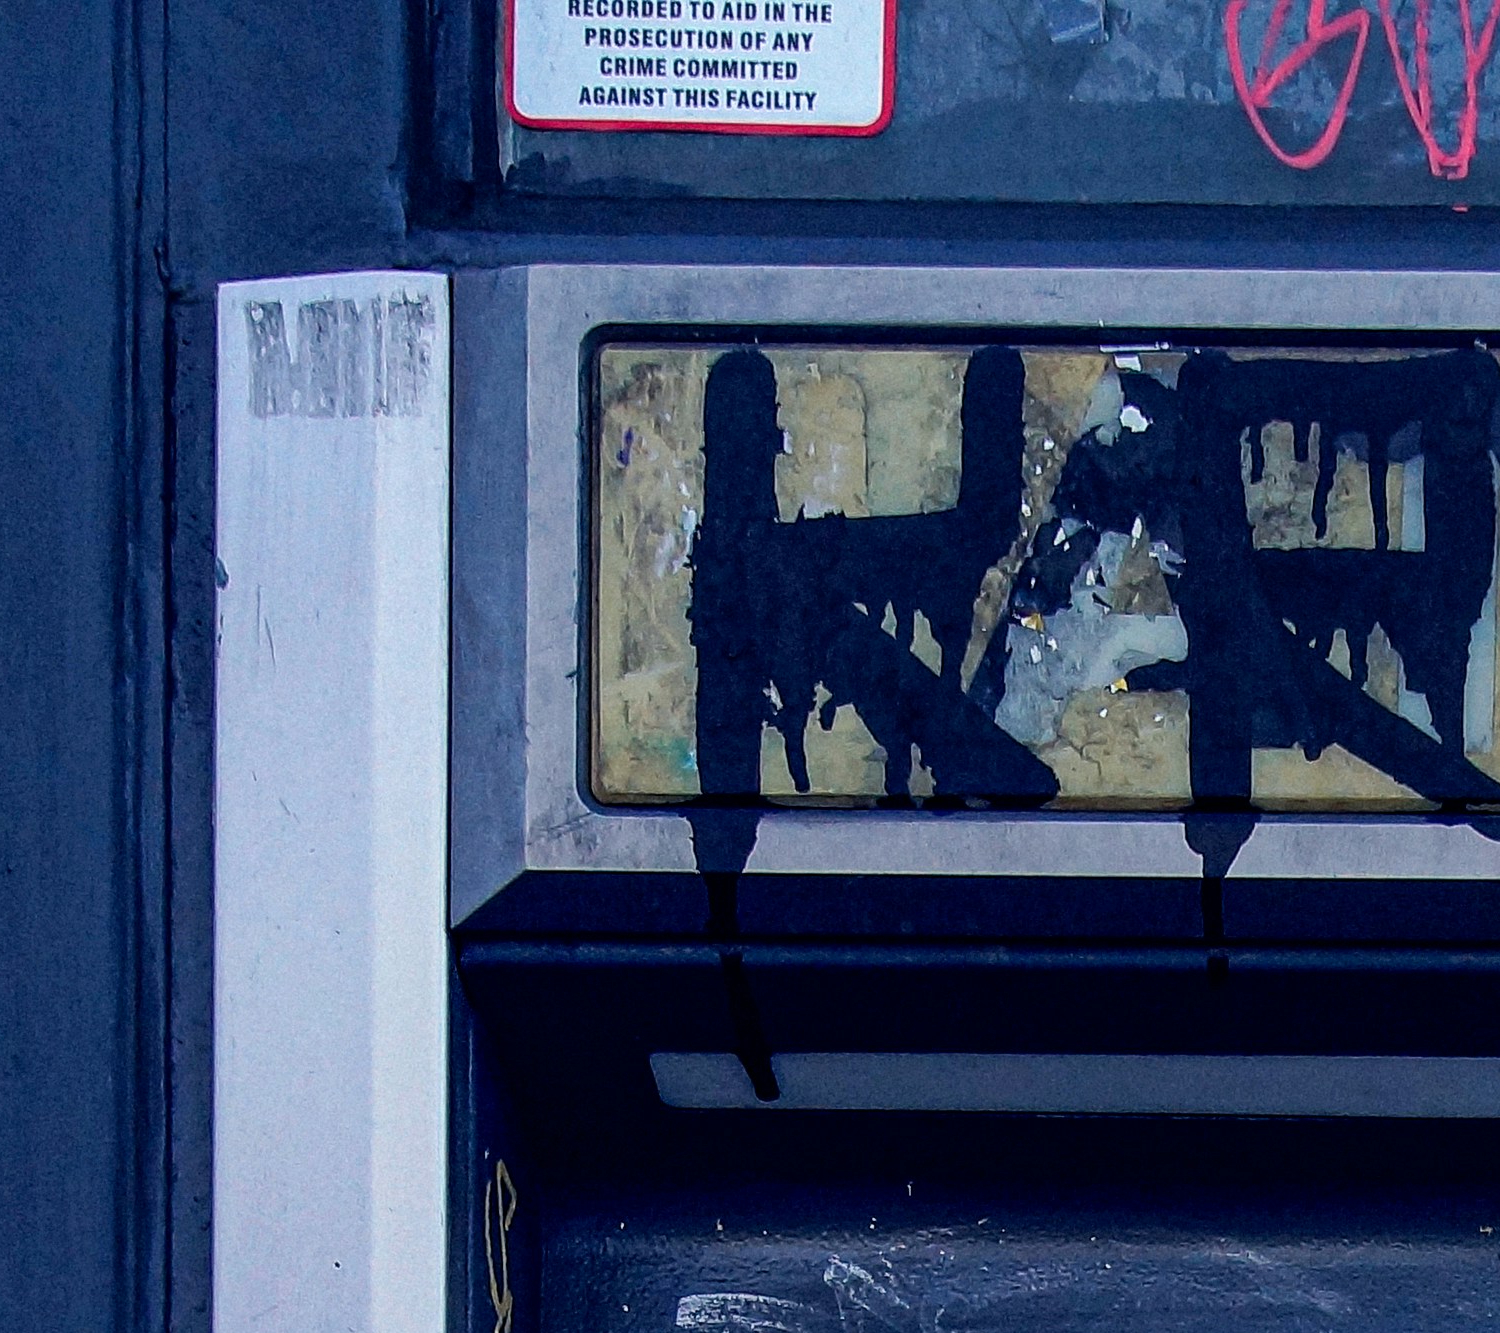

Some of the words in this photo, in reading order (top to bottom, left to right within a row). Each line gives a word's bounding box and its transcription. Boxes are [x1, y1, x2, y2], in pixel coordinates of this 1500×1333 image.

[568, 0, 681, 18] RECORDED
[691, 0, 715, 20] TO
[722, 1, 757, 21] AID
[765, 2, 785, 22] IN
[792, 3, 832, 23] THE
[585, 28, 733, 50] PROSECUTION
[740, 31, 766, 51] OF
[773, 32, 812, 52] ANY
[600, 56, 666, 77] CRIME
[673, 59, 798, 80] COMMITTED
[579, 86, 665, 107] AGAINST
[673, 88, 719, 108] THIS
[726, 90, 817, 111] FACILITY
